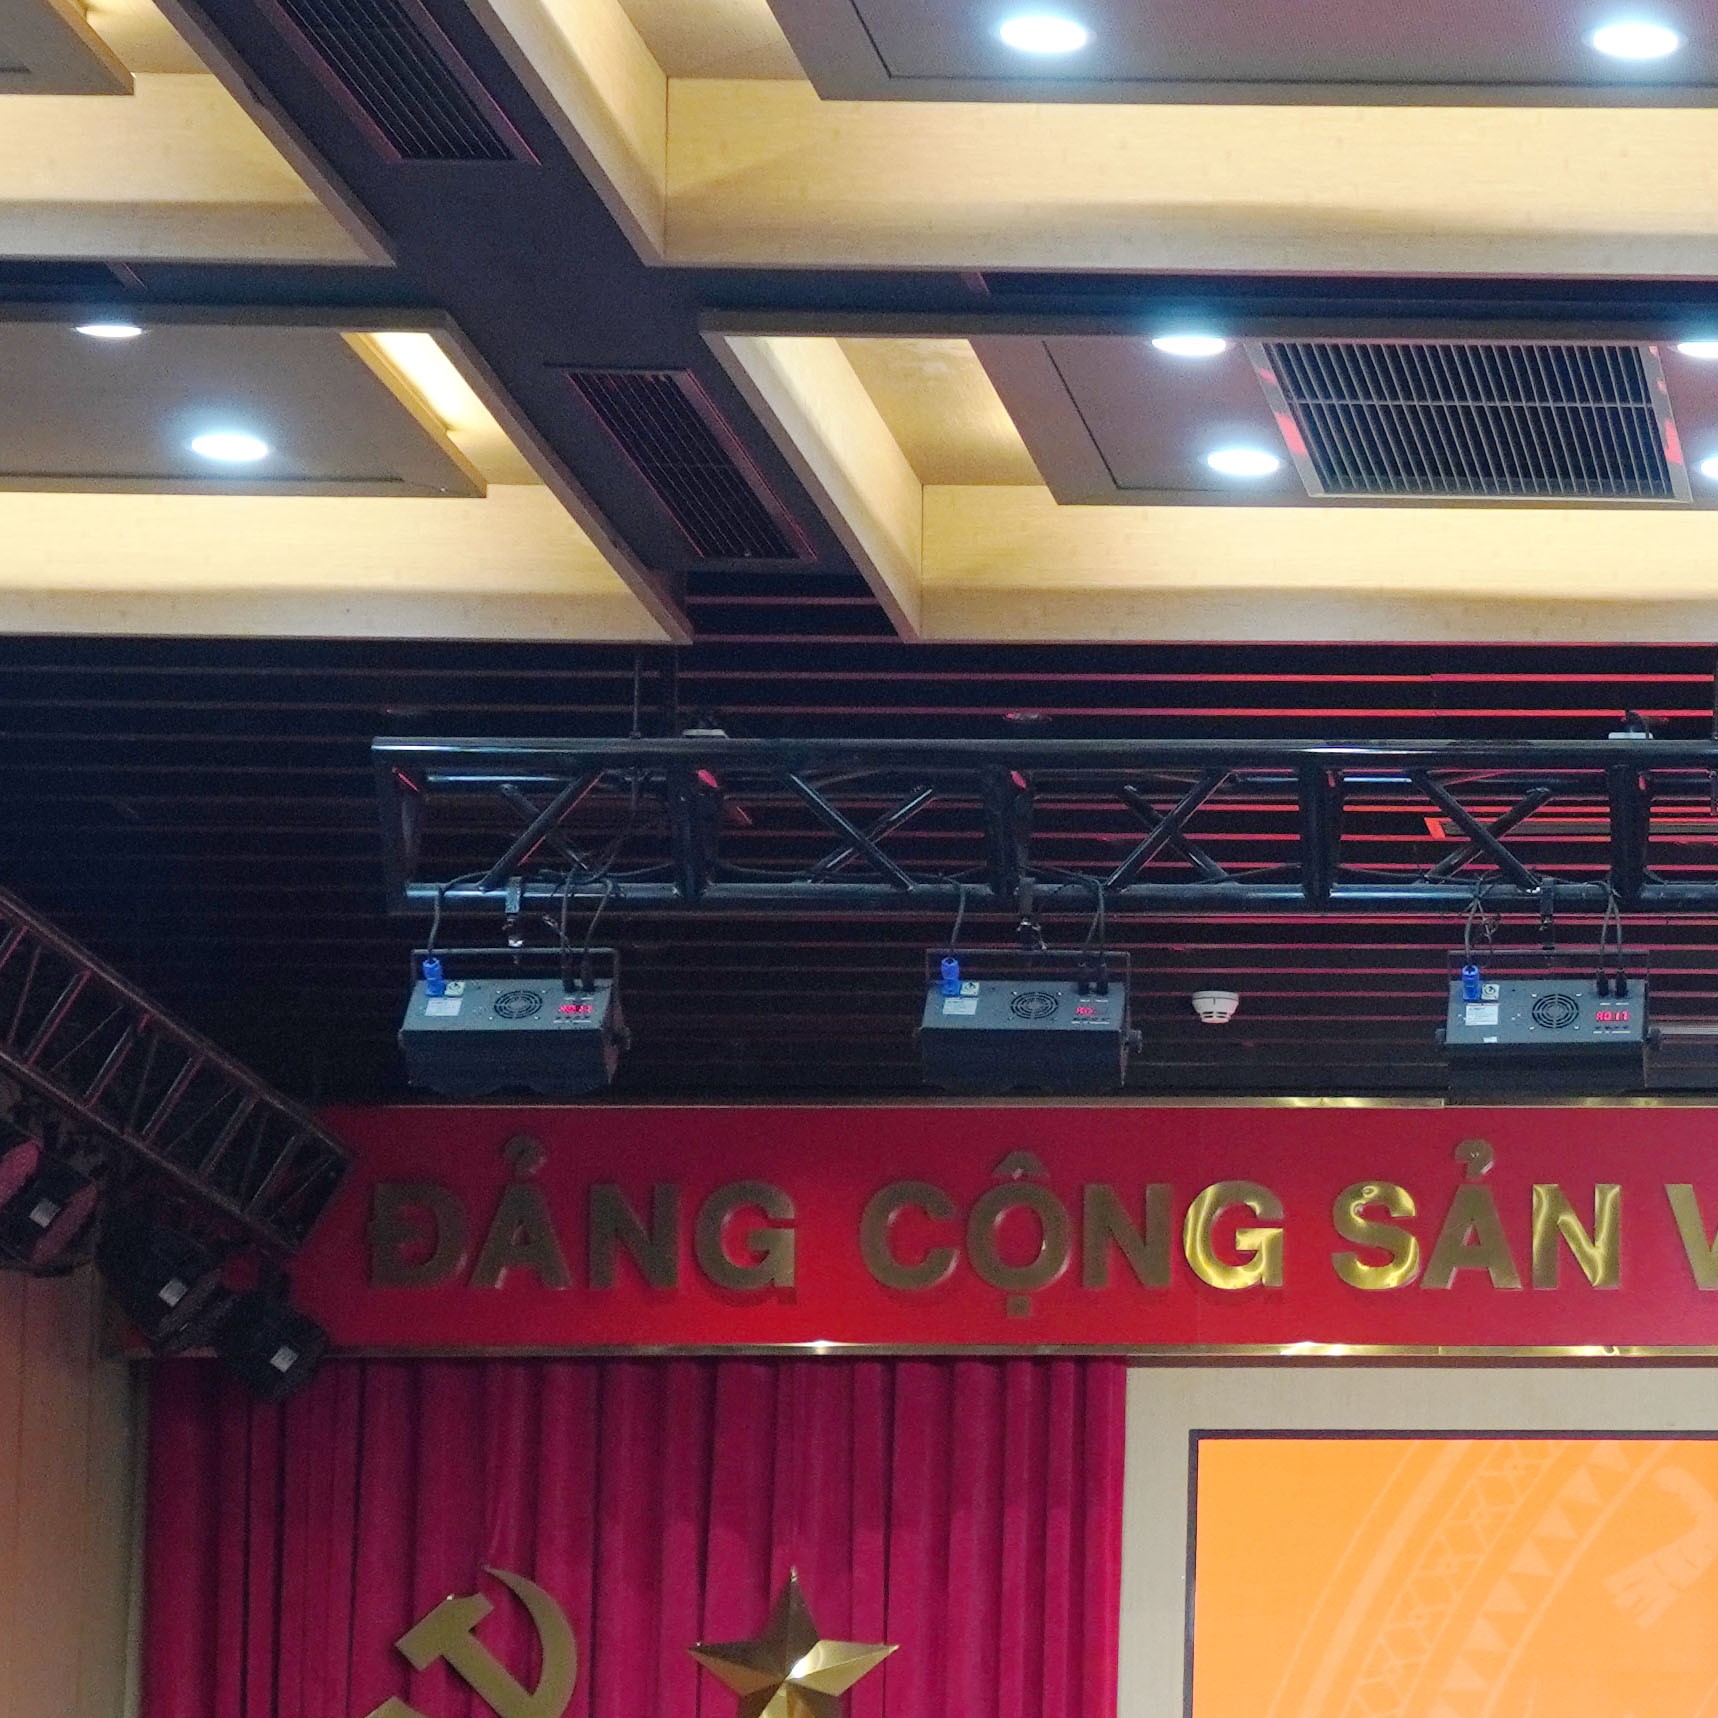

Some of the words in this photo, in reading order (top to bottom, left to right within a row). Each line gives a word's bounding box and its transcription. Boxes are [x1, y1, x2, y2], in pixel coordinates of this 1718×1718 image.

[368, 1133, 795, 1290] ĐẢNG
[860, 1151, 1285, 1316] CỘNG
[1331, 1140, 1621, 1290] SẢN
